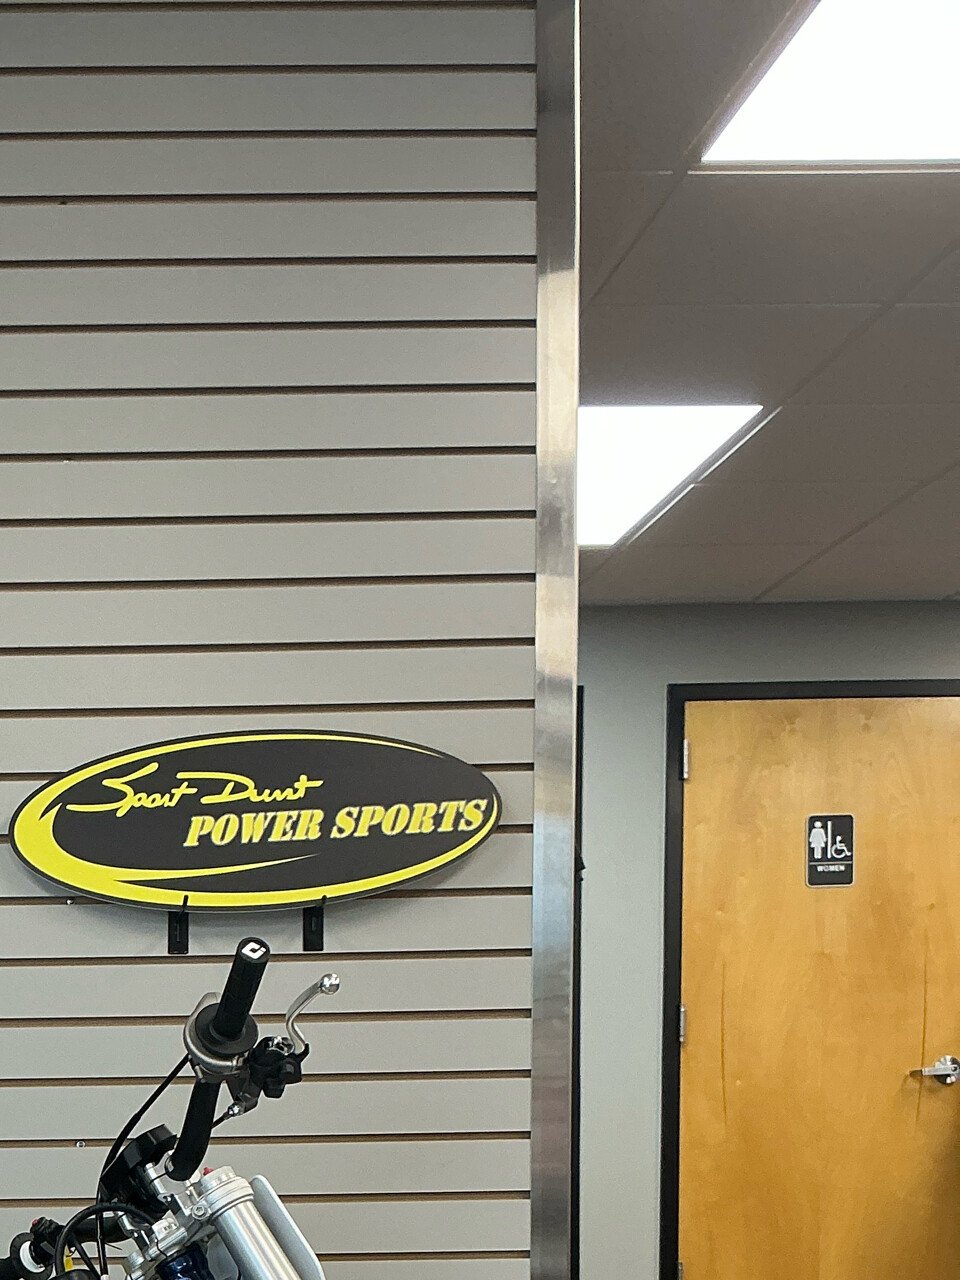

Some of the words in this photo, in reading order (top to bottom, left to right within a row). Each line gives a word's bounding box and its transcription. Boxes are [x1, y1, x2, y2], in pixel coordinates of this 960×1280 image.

[66, 762, 197, 817] Sport
[183, 809, 324, 848] POWER
[330, 799, 488, 838] SPORTS
[816, 864, 845, 873] WOMEN
